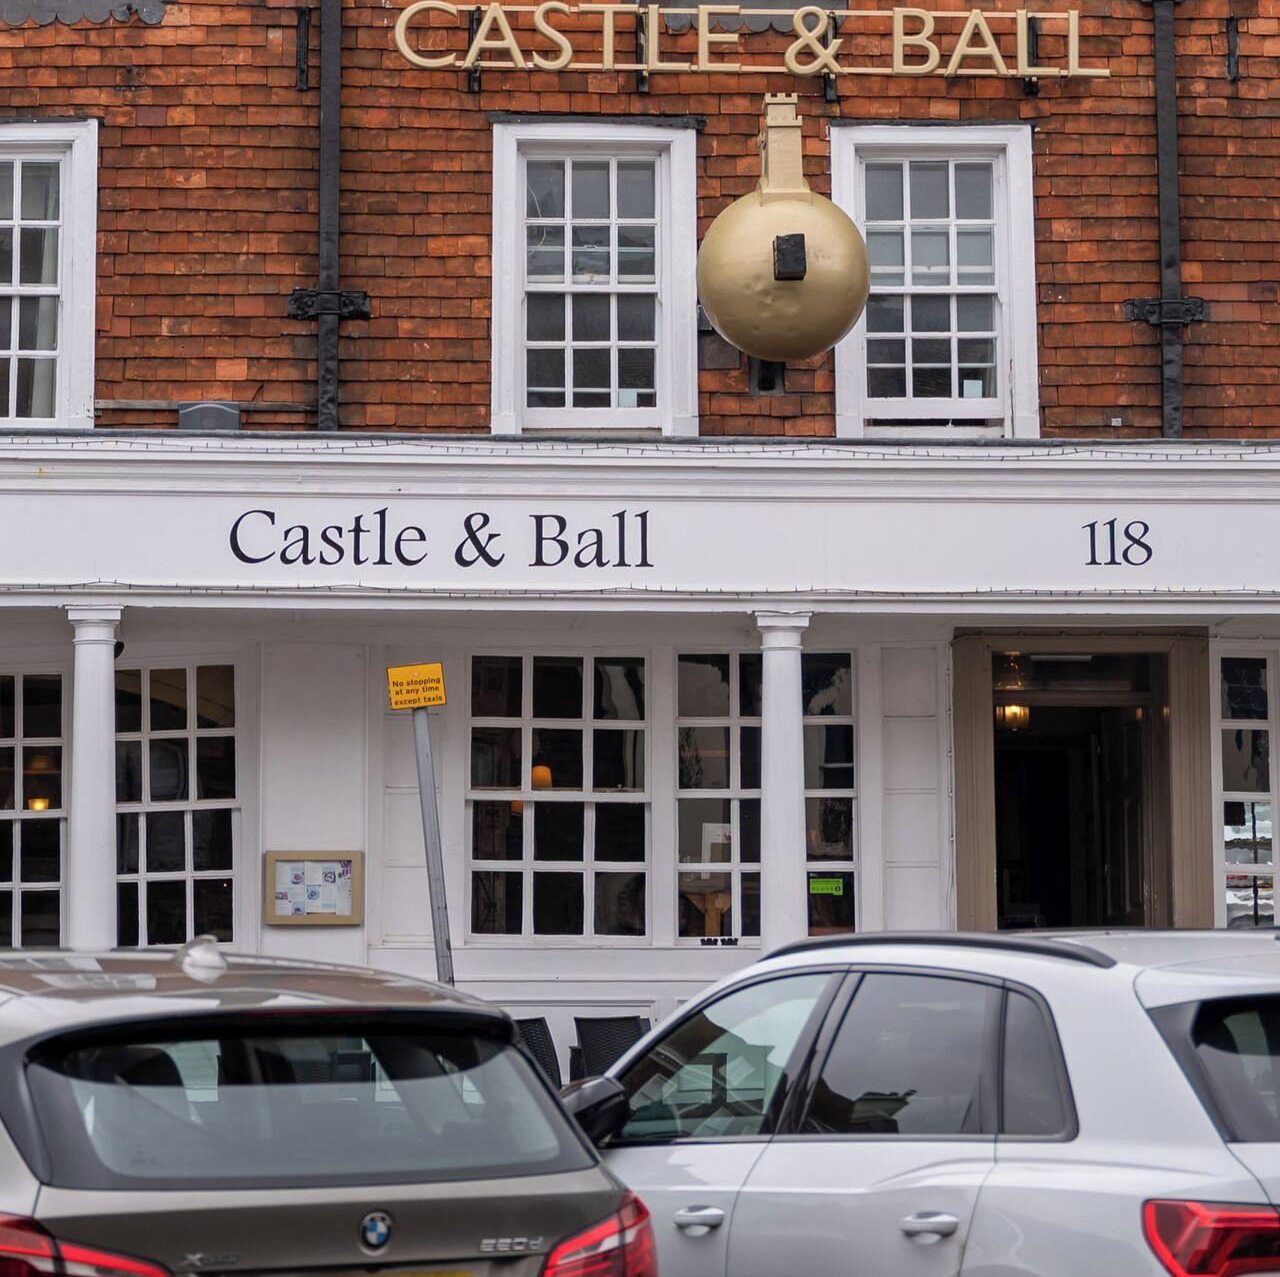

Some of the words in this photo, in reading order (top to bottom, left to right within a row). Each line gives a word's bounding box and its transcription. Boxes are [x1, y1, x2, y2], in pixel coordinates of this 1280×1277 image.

[394, 0, 742, 74] CASTLE
[785, 5, 844, 76] &
[892, 6, 1112, 79] BALL
[228, 506, 429, 567] Castle
[453, 511, 506, 569] &
[528, 508, 655, 569] Ball
[1081, 517, 1153, 566] 118
[392, 680, 404, 688] No
[406, 677, 441, 686] stopping
[394, 697, 422, 706] except
[423, 695, 443, 703] taxis
